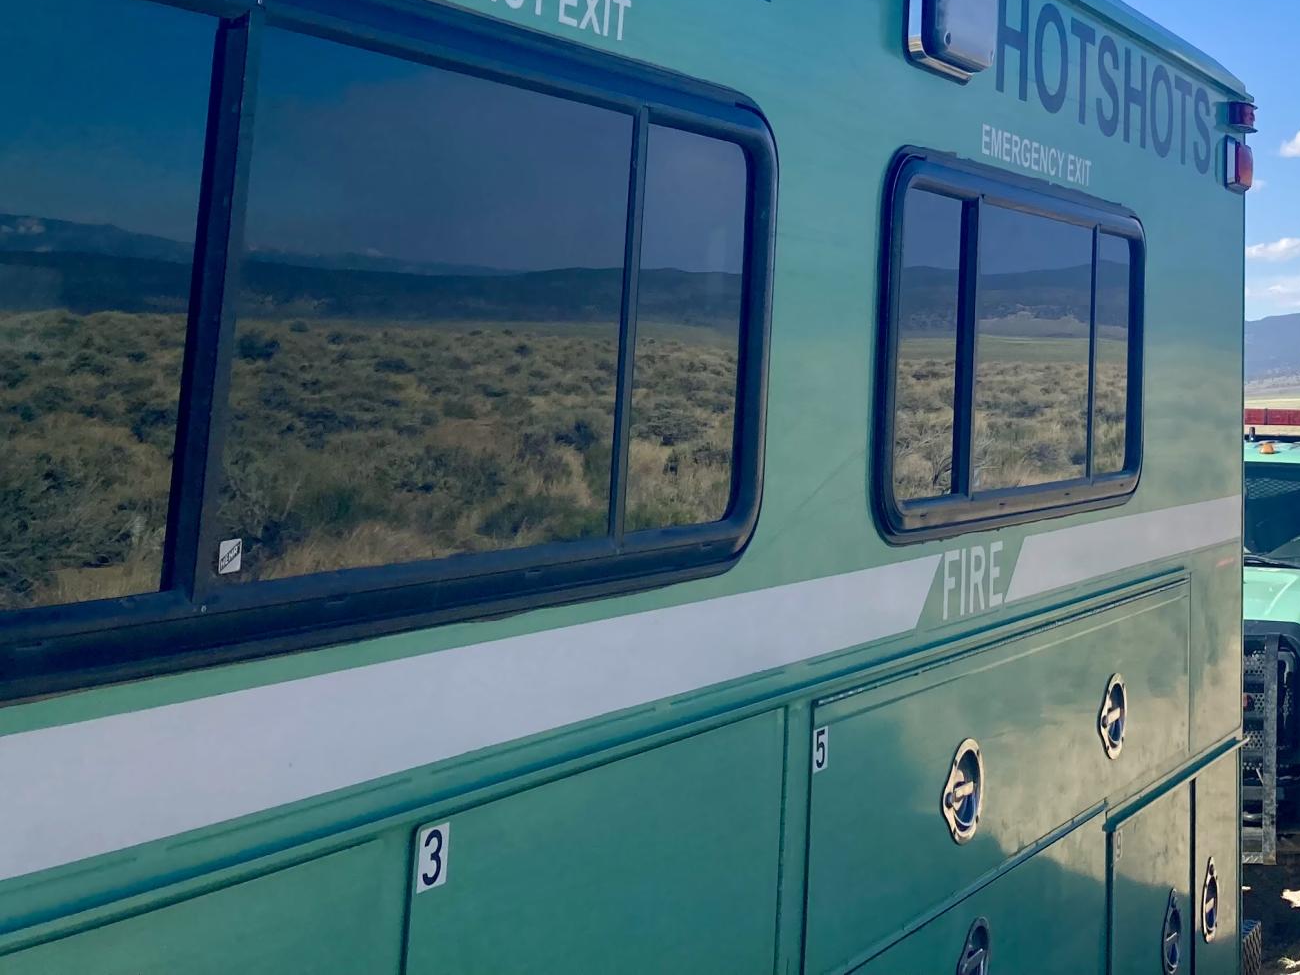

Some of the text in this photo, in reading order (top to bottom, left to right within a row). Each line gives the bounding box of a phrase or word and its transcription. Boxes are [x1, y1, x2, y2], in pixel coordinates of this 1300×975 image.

[981, 123, 1092, 186] EMERGENCY EXIT
[943, 541, 1003, 620] FIRE
[816, 728, 825, 769] 5
[422, 829, 442, 886] 3
